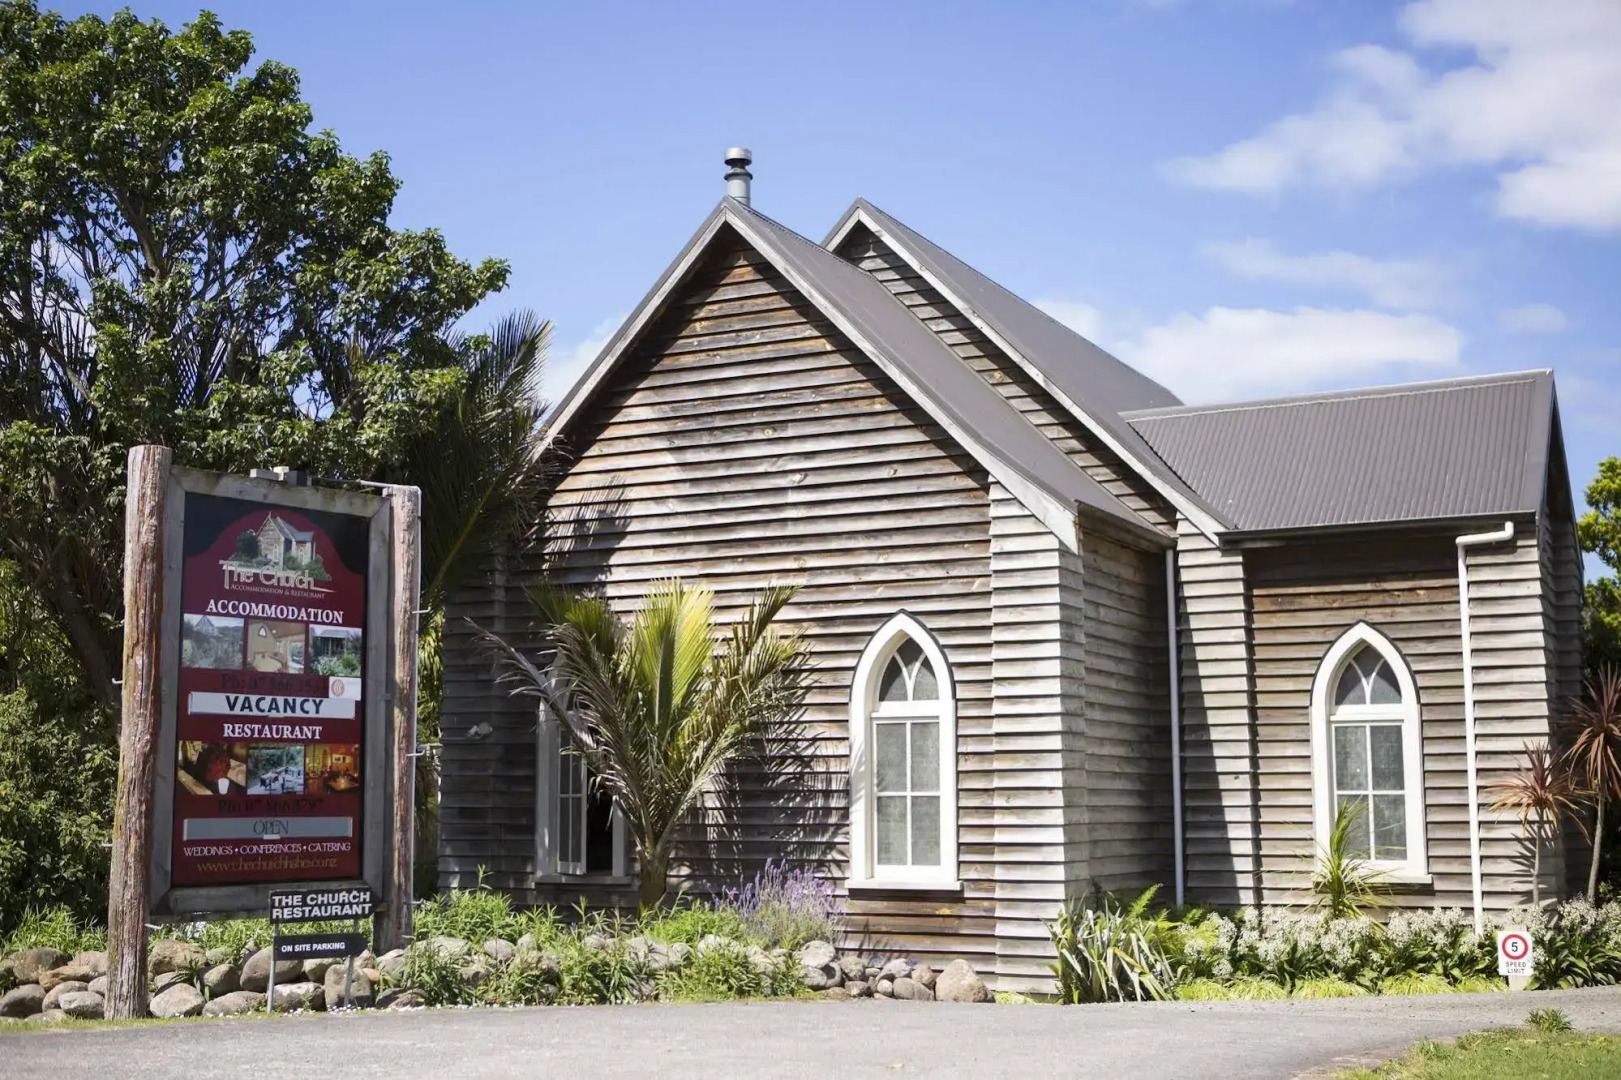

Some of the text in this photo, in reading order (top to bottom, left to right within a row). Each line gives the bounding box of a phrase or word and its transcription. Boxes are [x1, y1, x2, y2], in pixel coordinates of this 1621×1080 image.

[219, 560, 330, 592] The Church
[205, 598, 344, 624] ACCOMMODATION
[225, 695, 324, 715] VACANCY
[223, 723, 323, 739] RESTAURANT
[253, 819, 289, 835] OPEN
[183, 842, 351, 857] WEDDINGS CONFERENCES CATERING
[272, 891, 370, 907] THE CHURCH
[272, 903, 372, 919] RESTAURANT
[281, 942, 345, 952] ON SITE PARKING
[1511, 942, 1518, 952] 5
